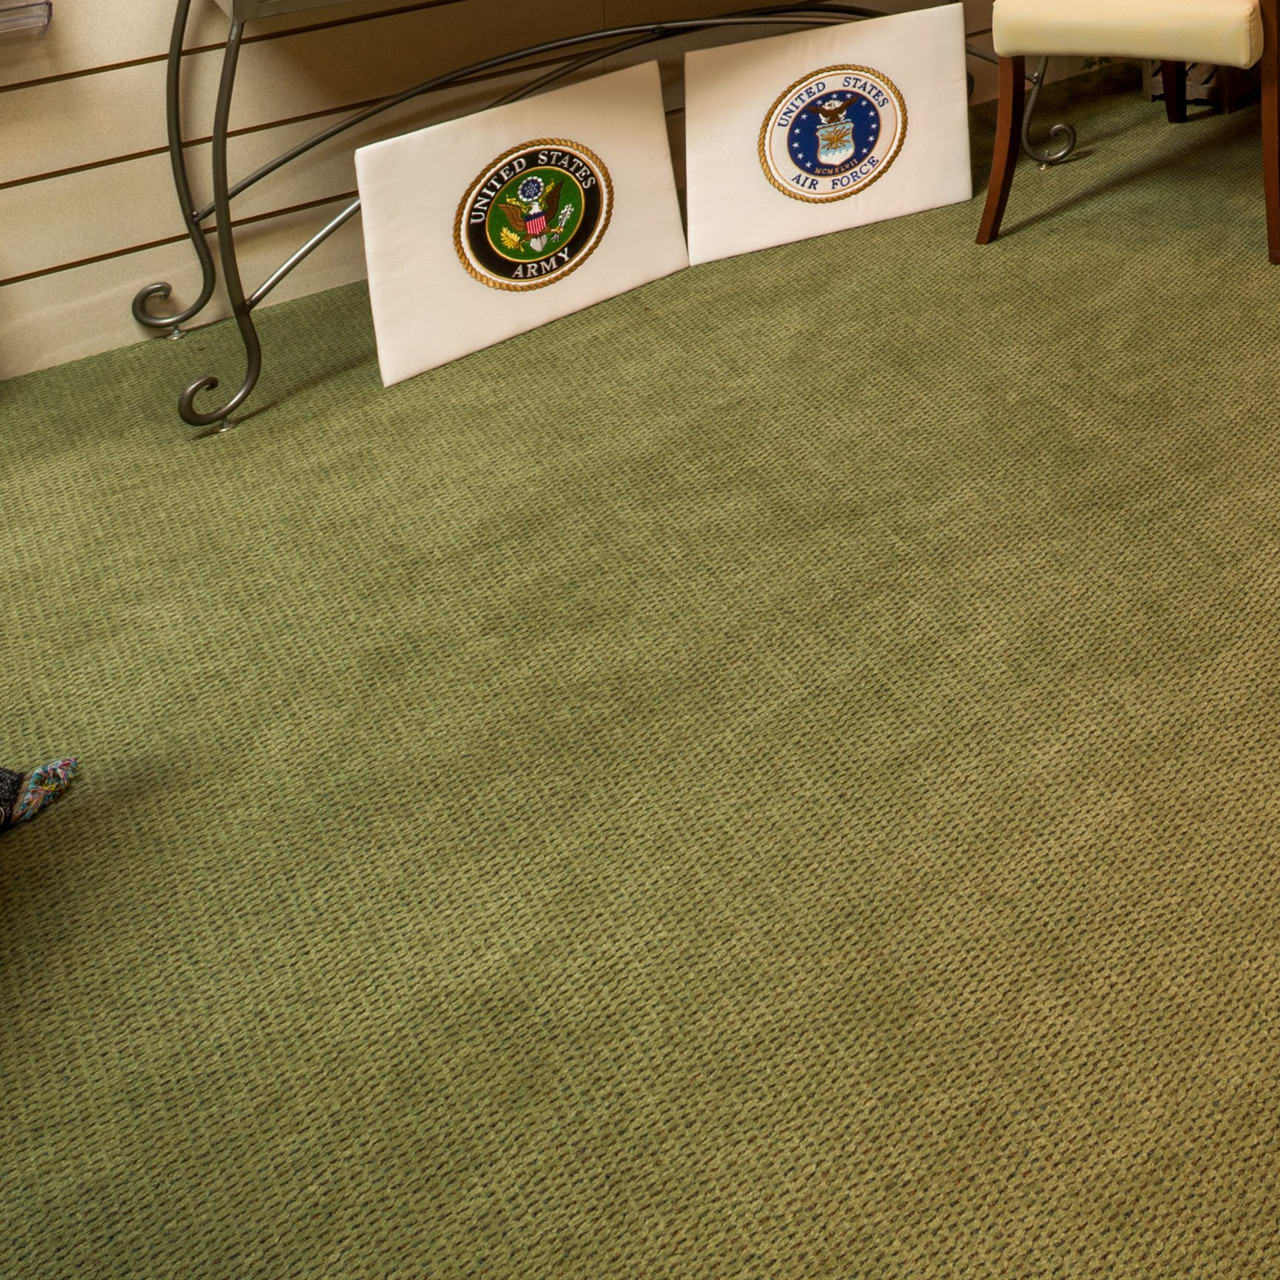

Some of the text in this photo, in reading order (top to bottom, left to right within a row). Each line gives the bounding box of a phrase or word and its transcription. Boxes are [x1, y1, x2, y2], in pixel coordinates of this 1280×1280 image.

[778, 76, 889, 128] UNITED STATES
[792, 155, 880, 191] AIR FORCE
[814, 158, 860, 175] MCMXLVII
[470, 150, 597, 224] UNITED STATES
[512, 247, 572, 279] ARMY
